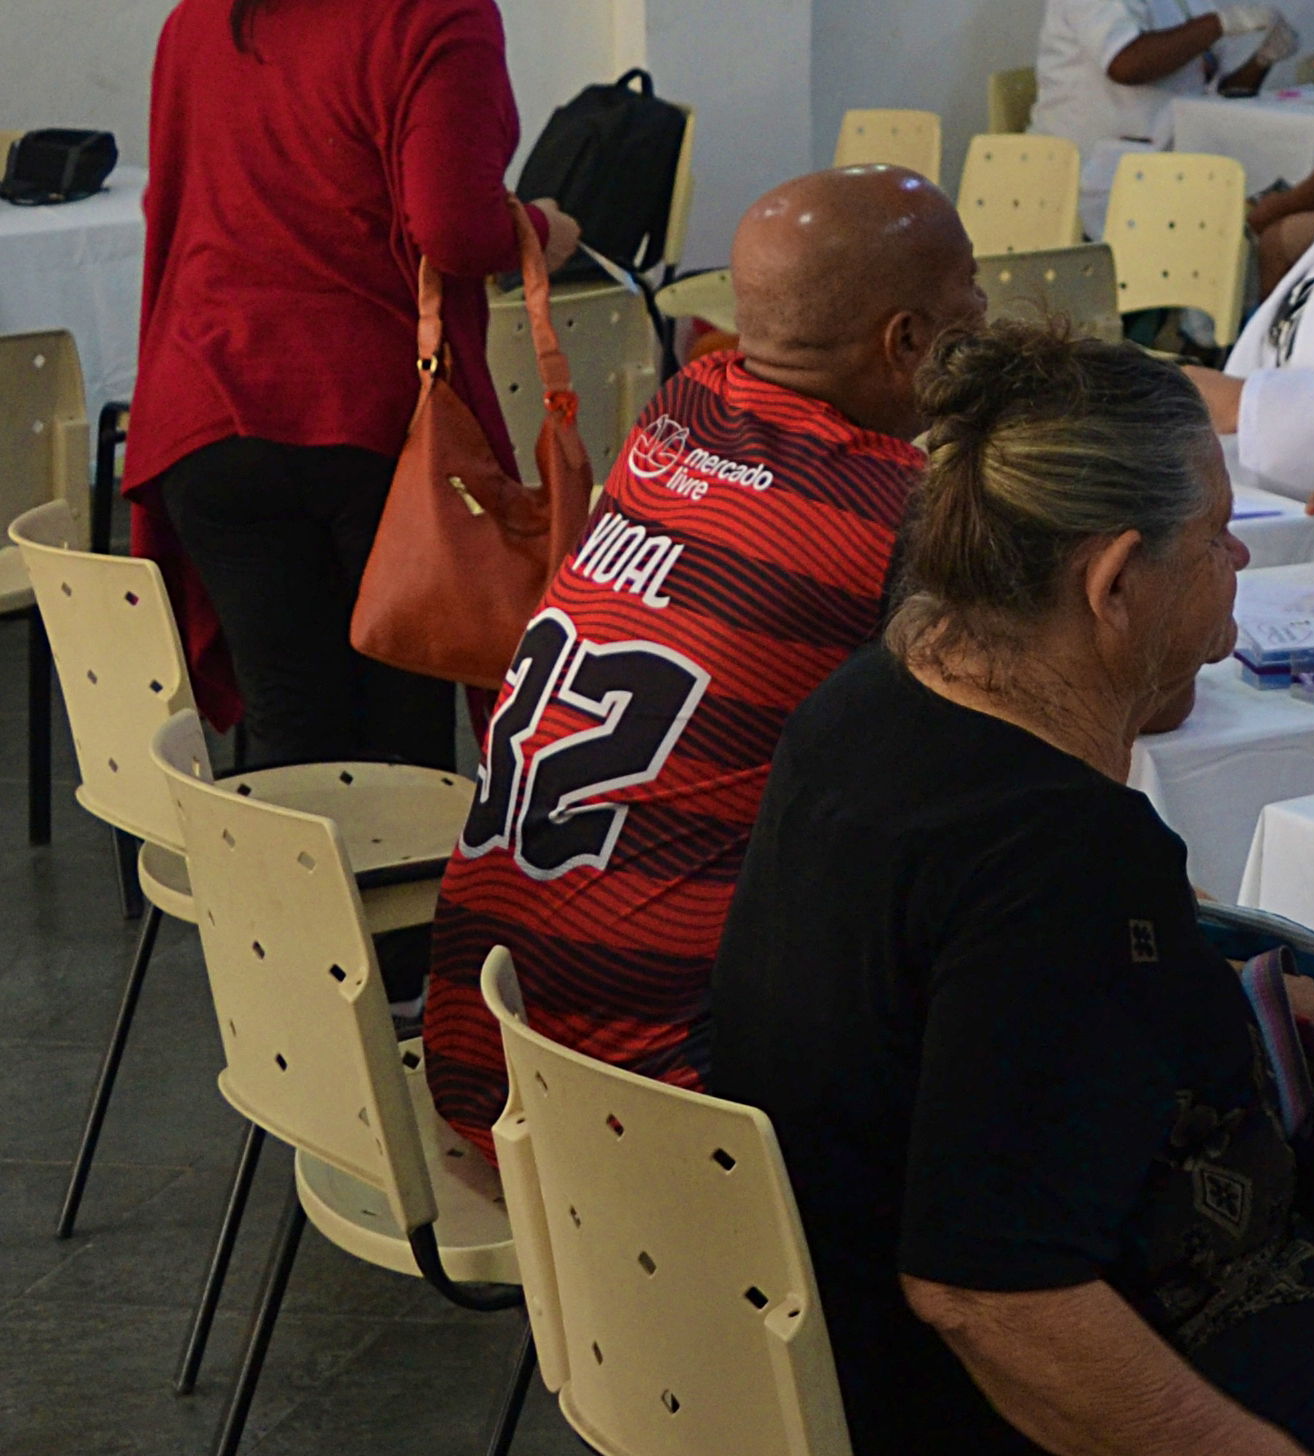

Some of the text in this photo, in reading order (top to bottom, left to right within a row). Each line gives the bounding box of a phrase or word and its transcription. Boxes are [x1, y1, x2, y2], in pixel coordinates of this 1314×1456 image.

[666, 464, 709, 501] livre
[684, 448, 774, 492] mercado
[571, 511, 686, 609] VIDAL
[458, 606, 713, 881] 32
